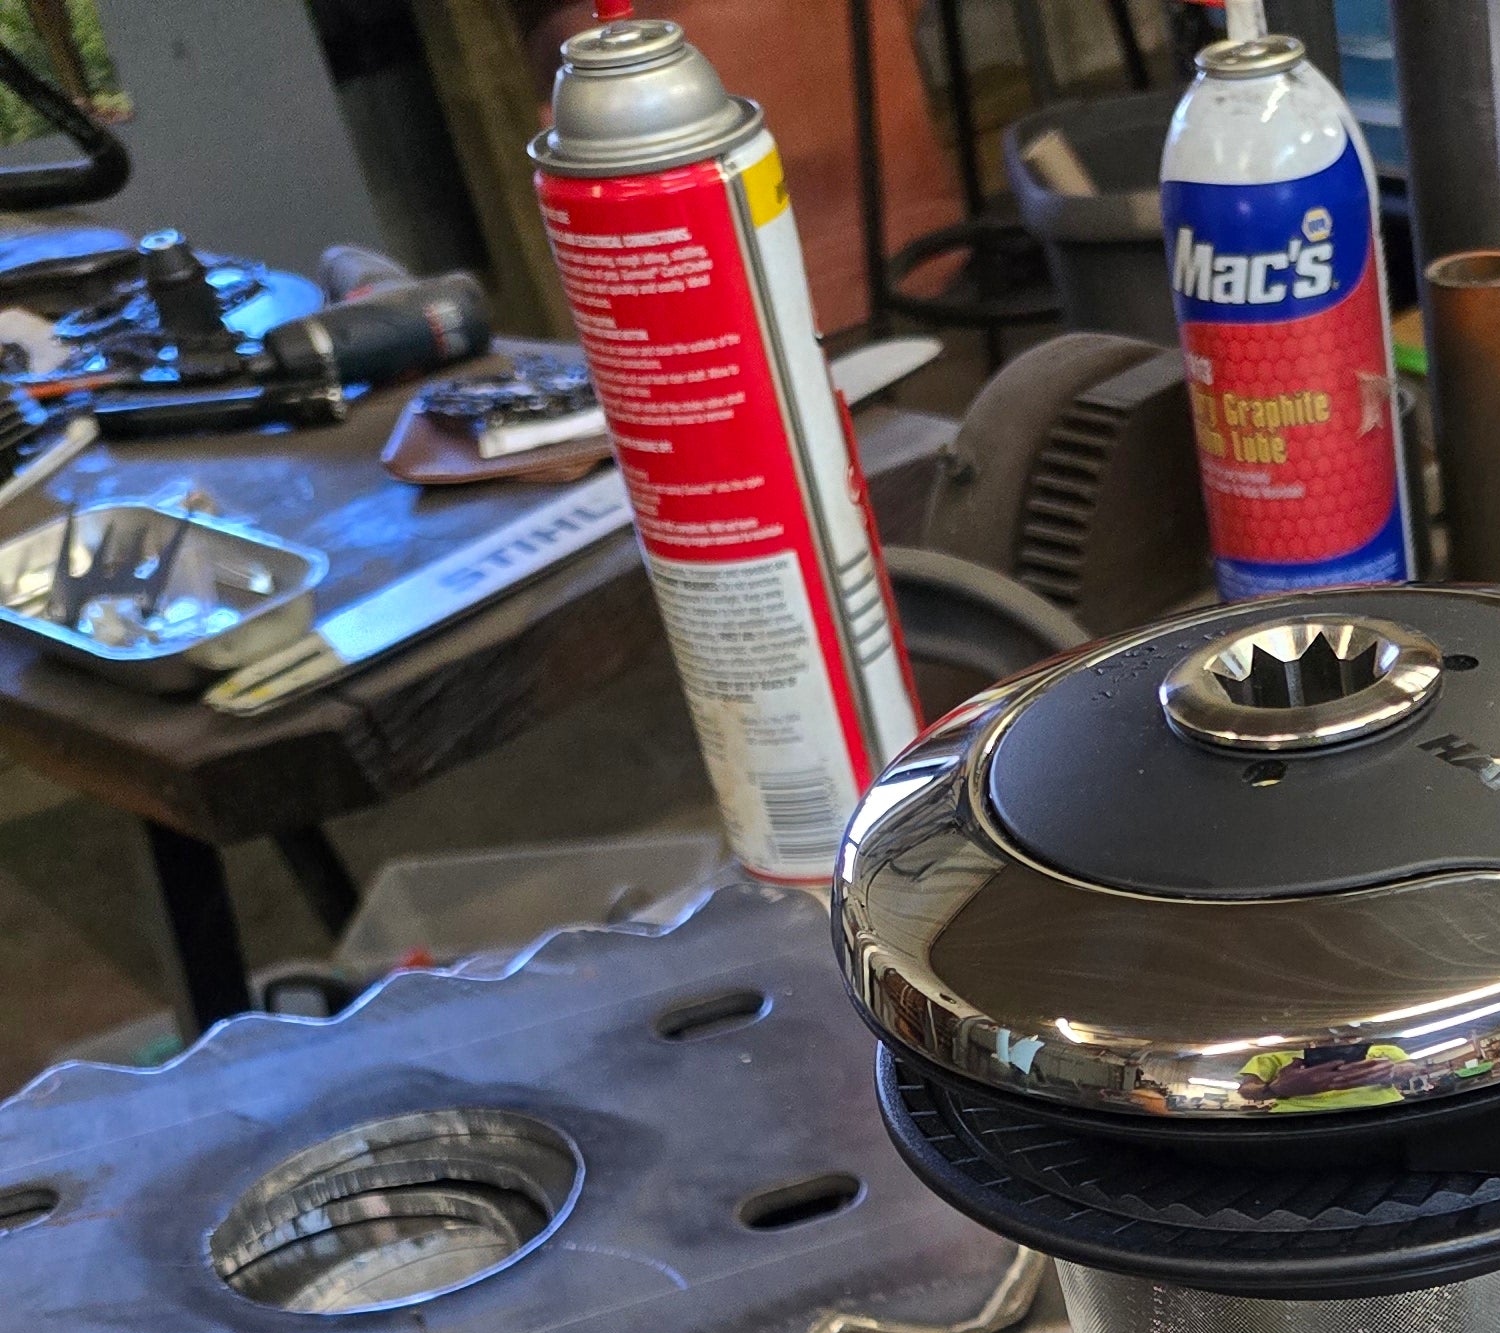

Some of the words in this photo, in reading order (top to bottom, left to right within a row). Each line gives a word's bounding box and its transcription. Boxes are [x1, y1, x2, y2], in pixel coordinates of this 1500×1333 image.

[1172, 227, 1333, 305] Mac's
[1223, 391, 1330, 433] Graphite
[1231, 430, 1287, 464] Lube
[438, 503, 624, 592] STIHL
